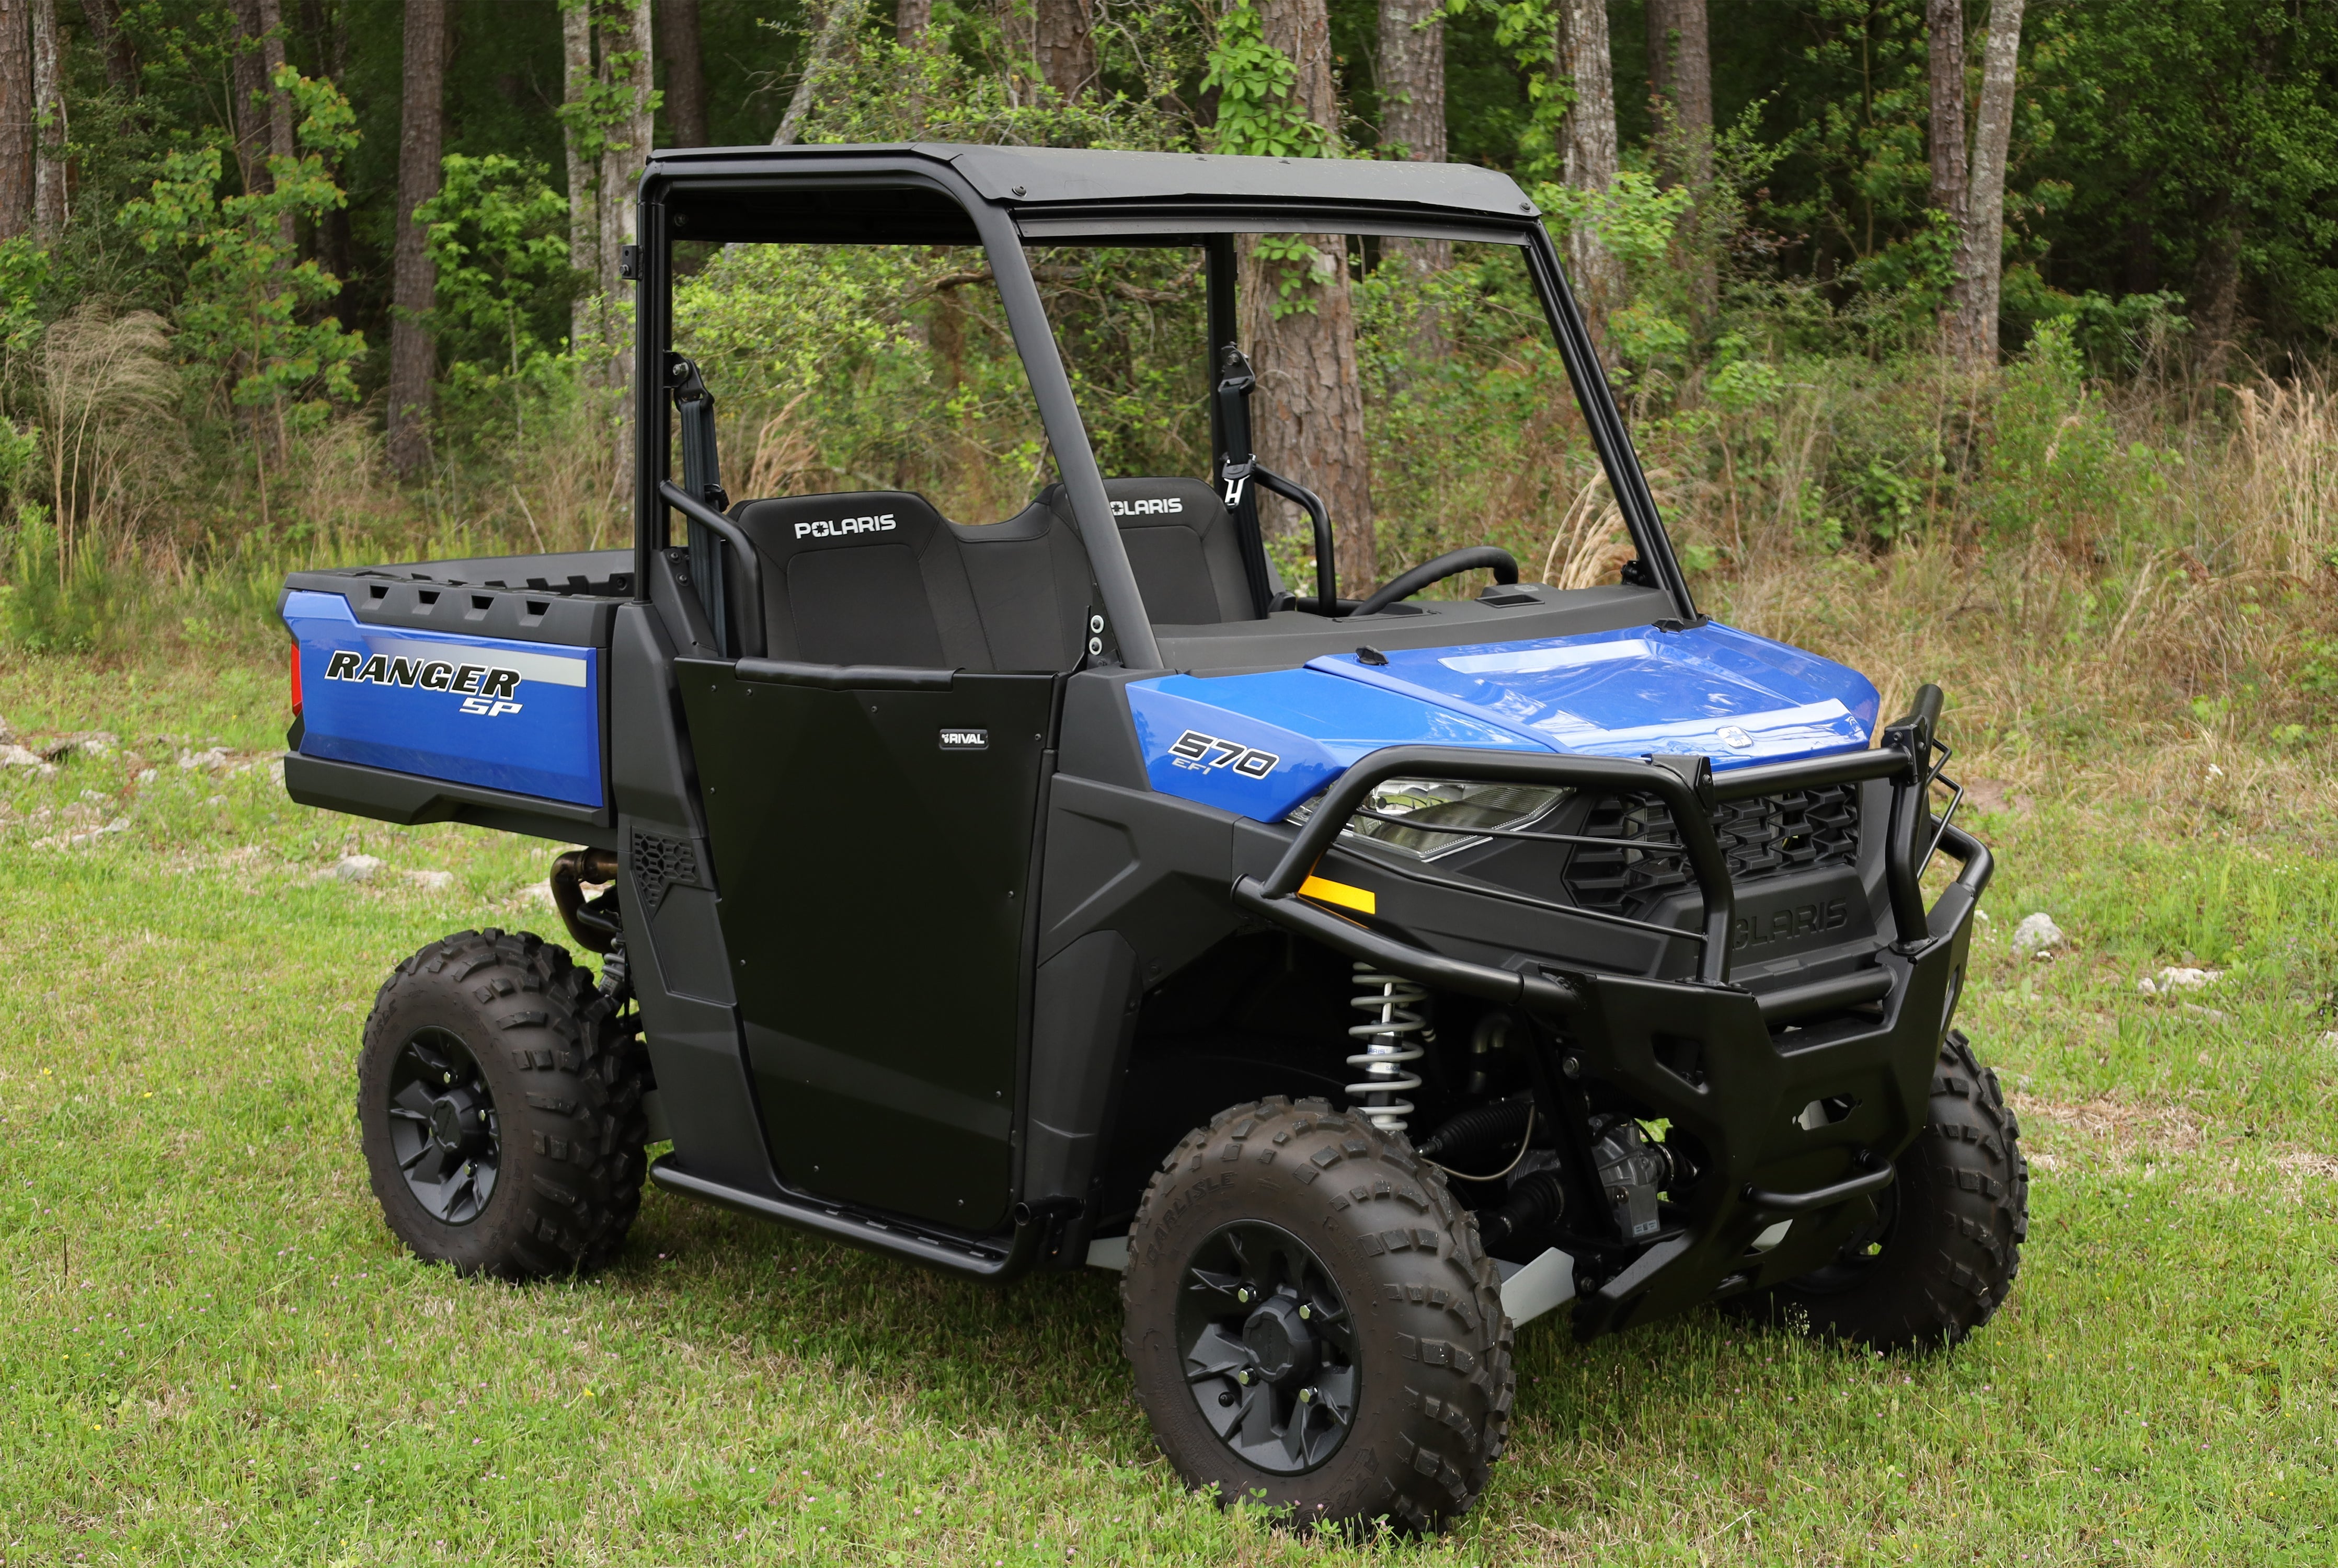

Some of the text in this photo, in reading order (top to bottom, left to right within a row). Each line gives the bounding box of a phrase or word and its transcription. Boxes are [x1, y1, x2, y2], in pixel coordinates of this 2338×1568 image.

[1110, 498, 1183, 516] OLARIS
[794, 514, 897, 539] POLARIS
[324, 650, 522, 700] RANGER
[459, 697, 523, 717] SP
[949, 733, 985, 744] RIVAL
[1167, 729, 1280, 780] 570
[1172, 757, 1211, 775] EFI
[1145, 1170, 1235, 1267] CARLISLE
